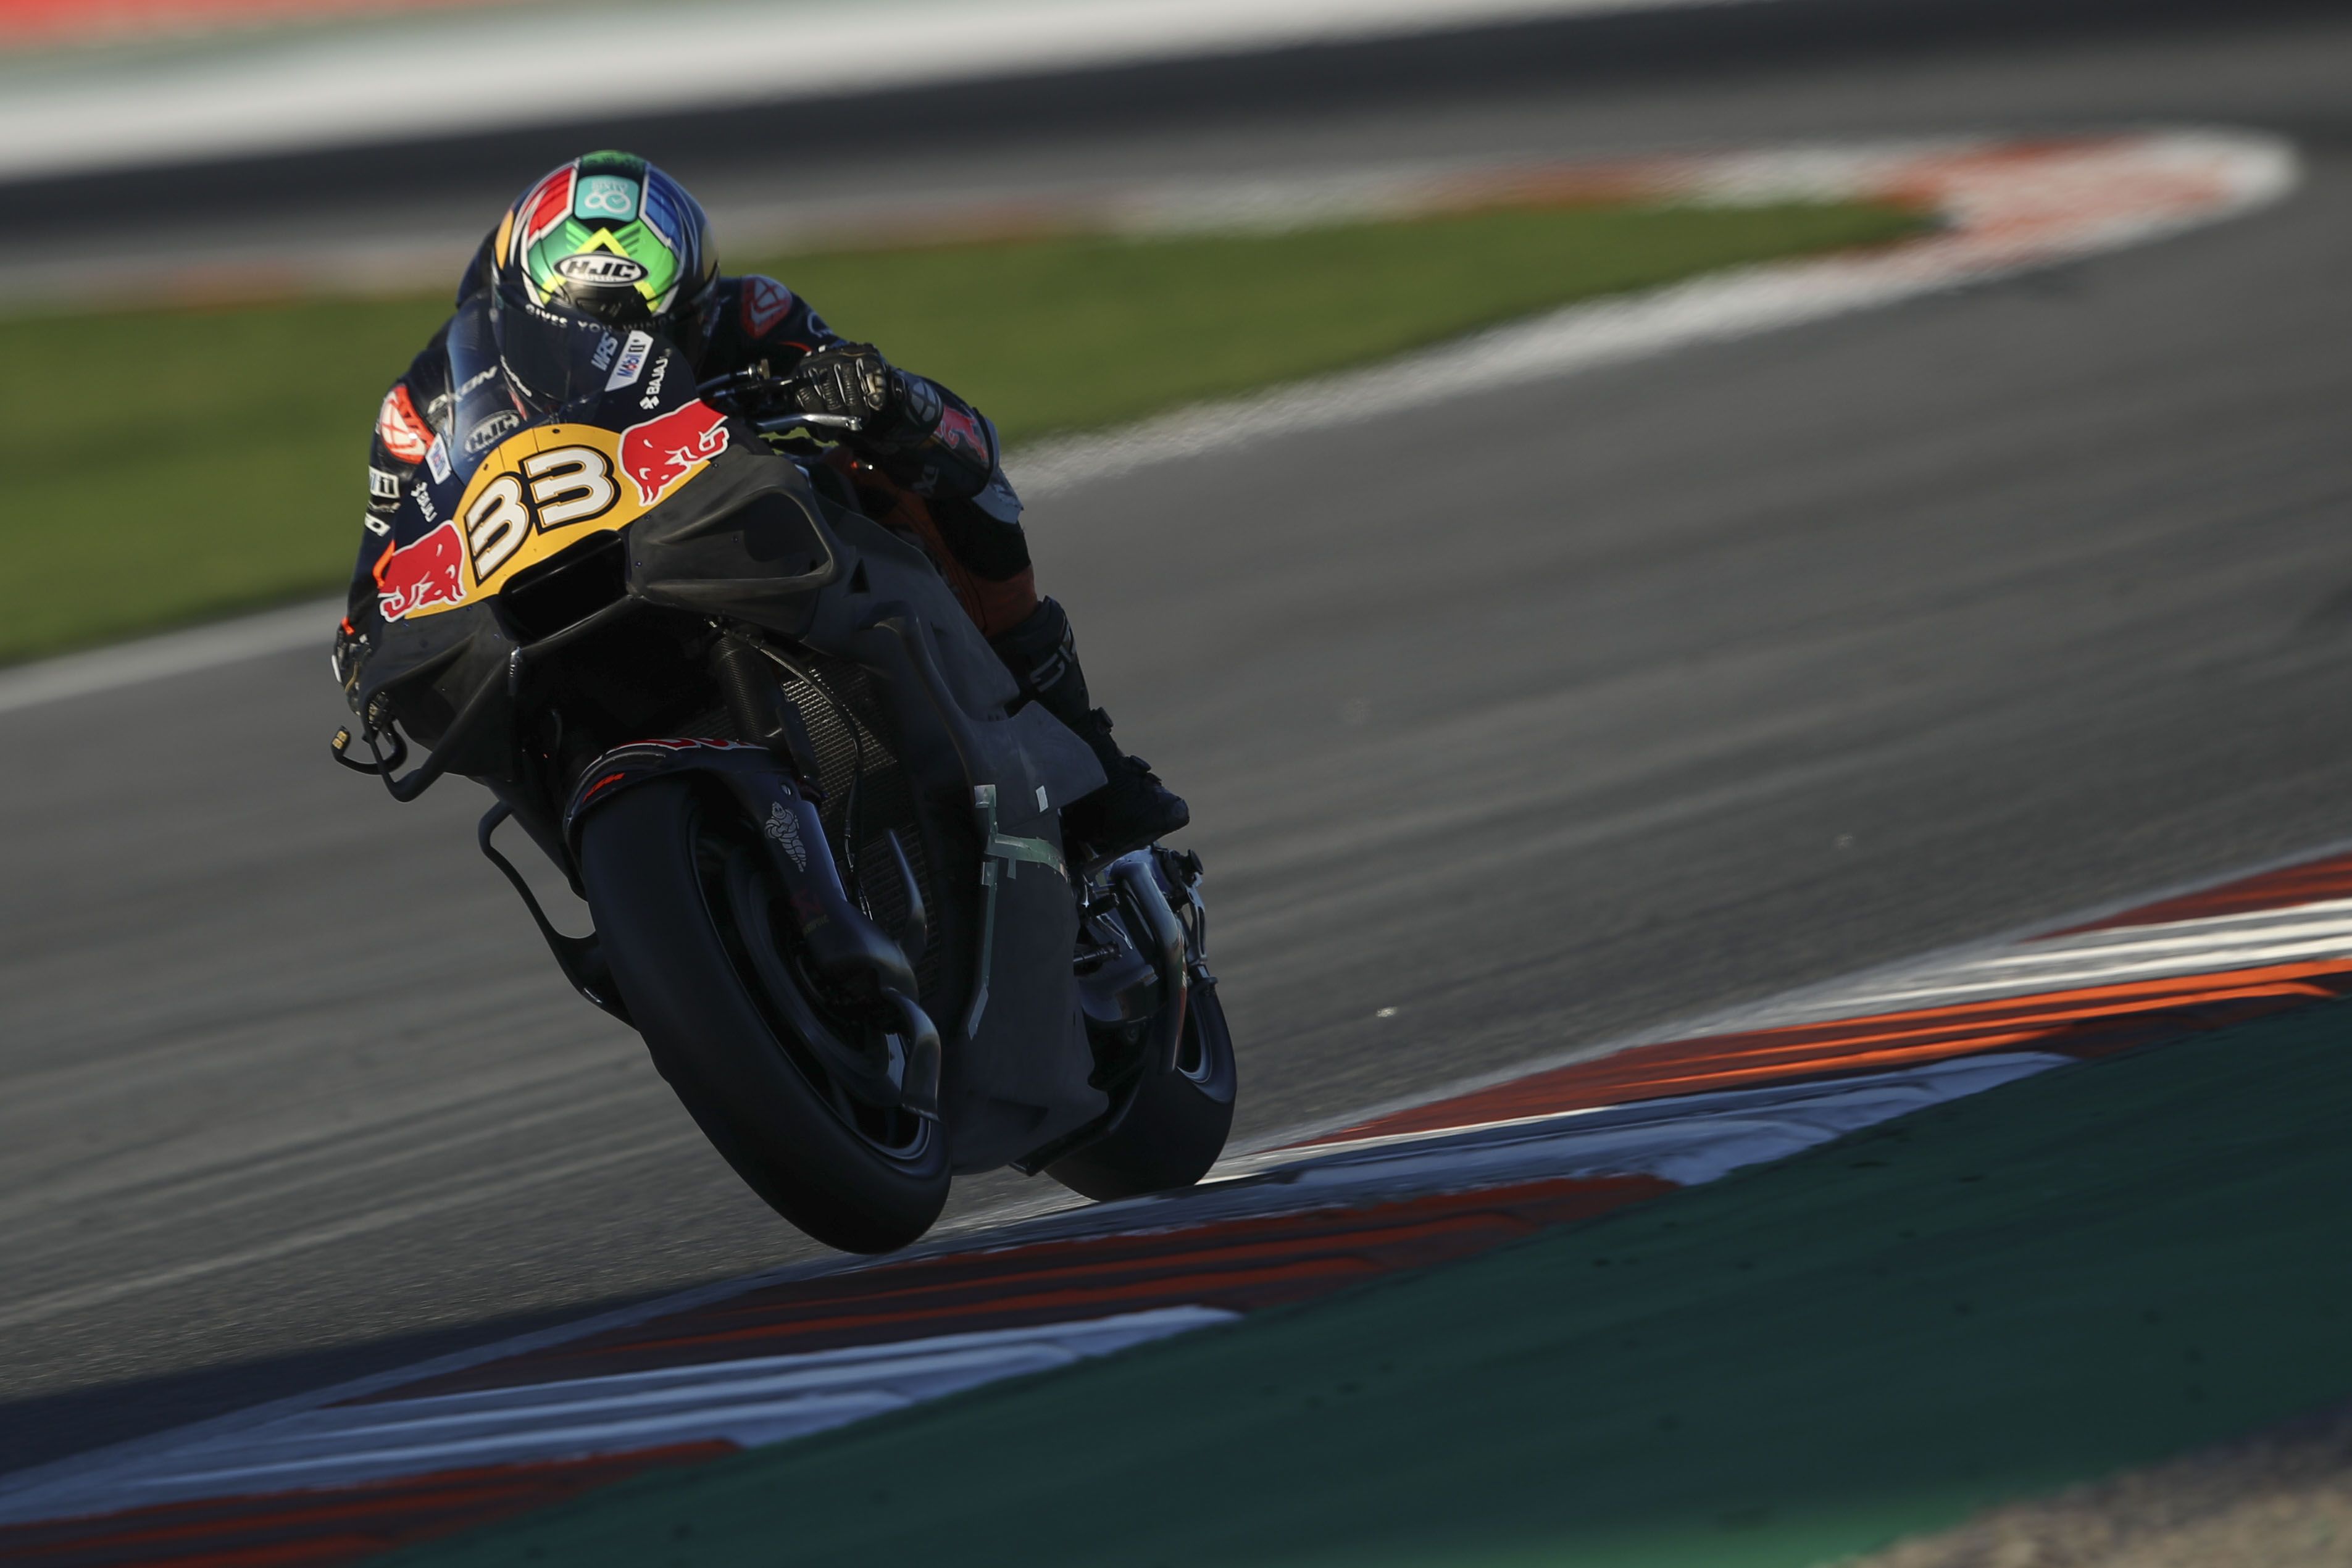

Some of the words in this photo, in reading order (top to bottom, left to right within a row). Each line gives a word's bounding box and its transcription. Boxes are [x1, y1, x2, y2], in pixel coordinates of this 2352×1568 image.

[565, 261, 636, 278] HJC
[590, 331, 619, 372] WRS
[617, 353, 641, 378] Mobil
[646, 356, 669, 395] BAJAJ
[470, 414, 512, 450] HJC
[464, 445, 621, 586] 33
